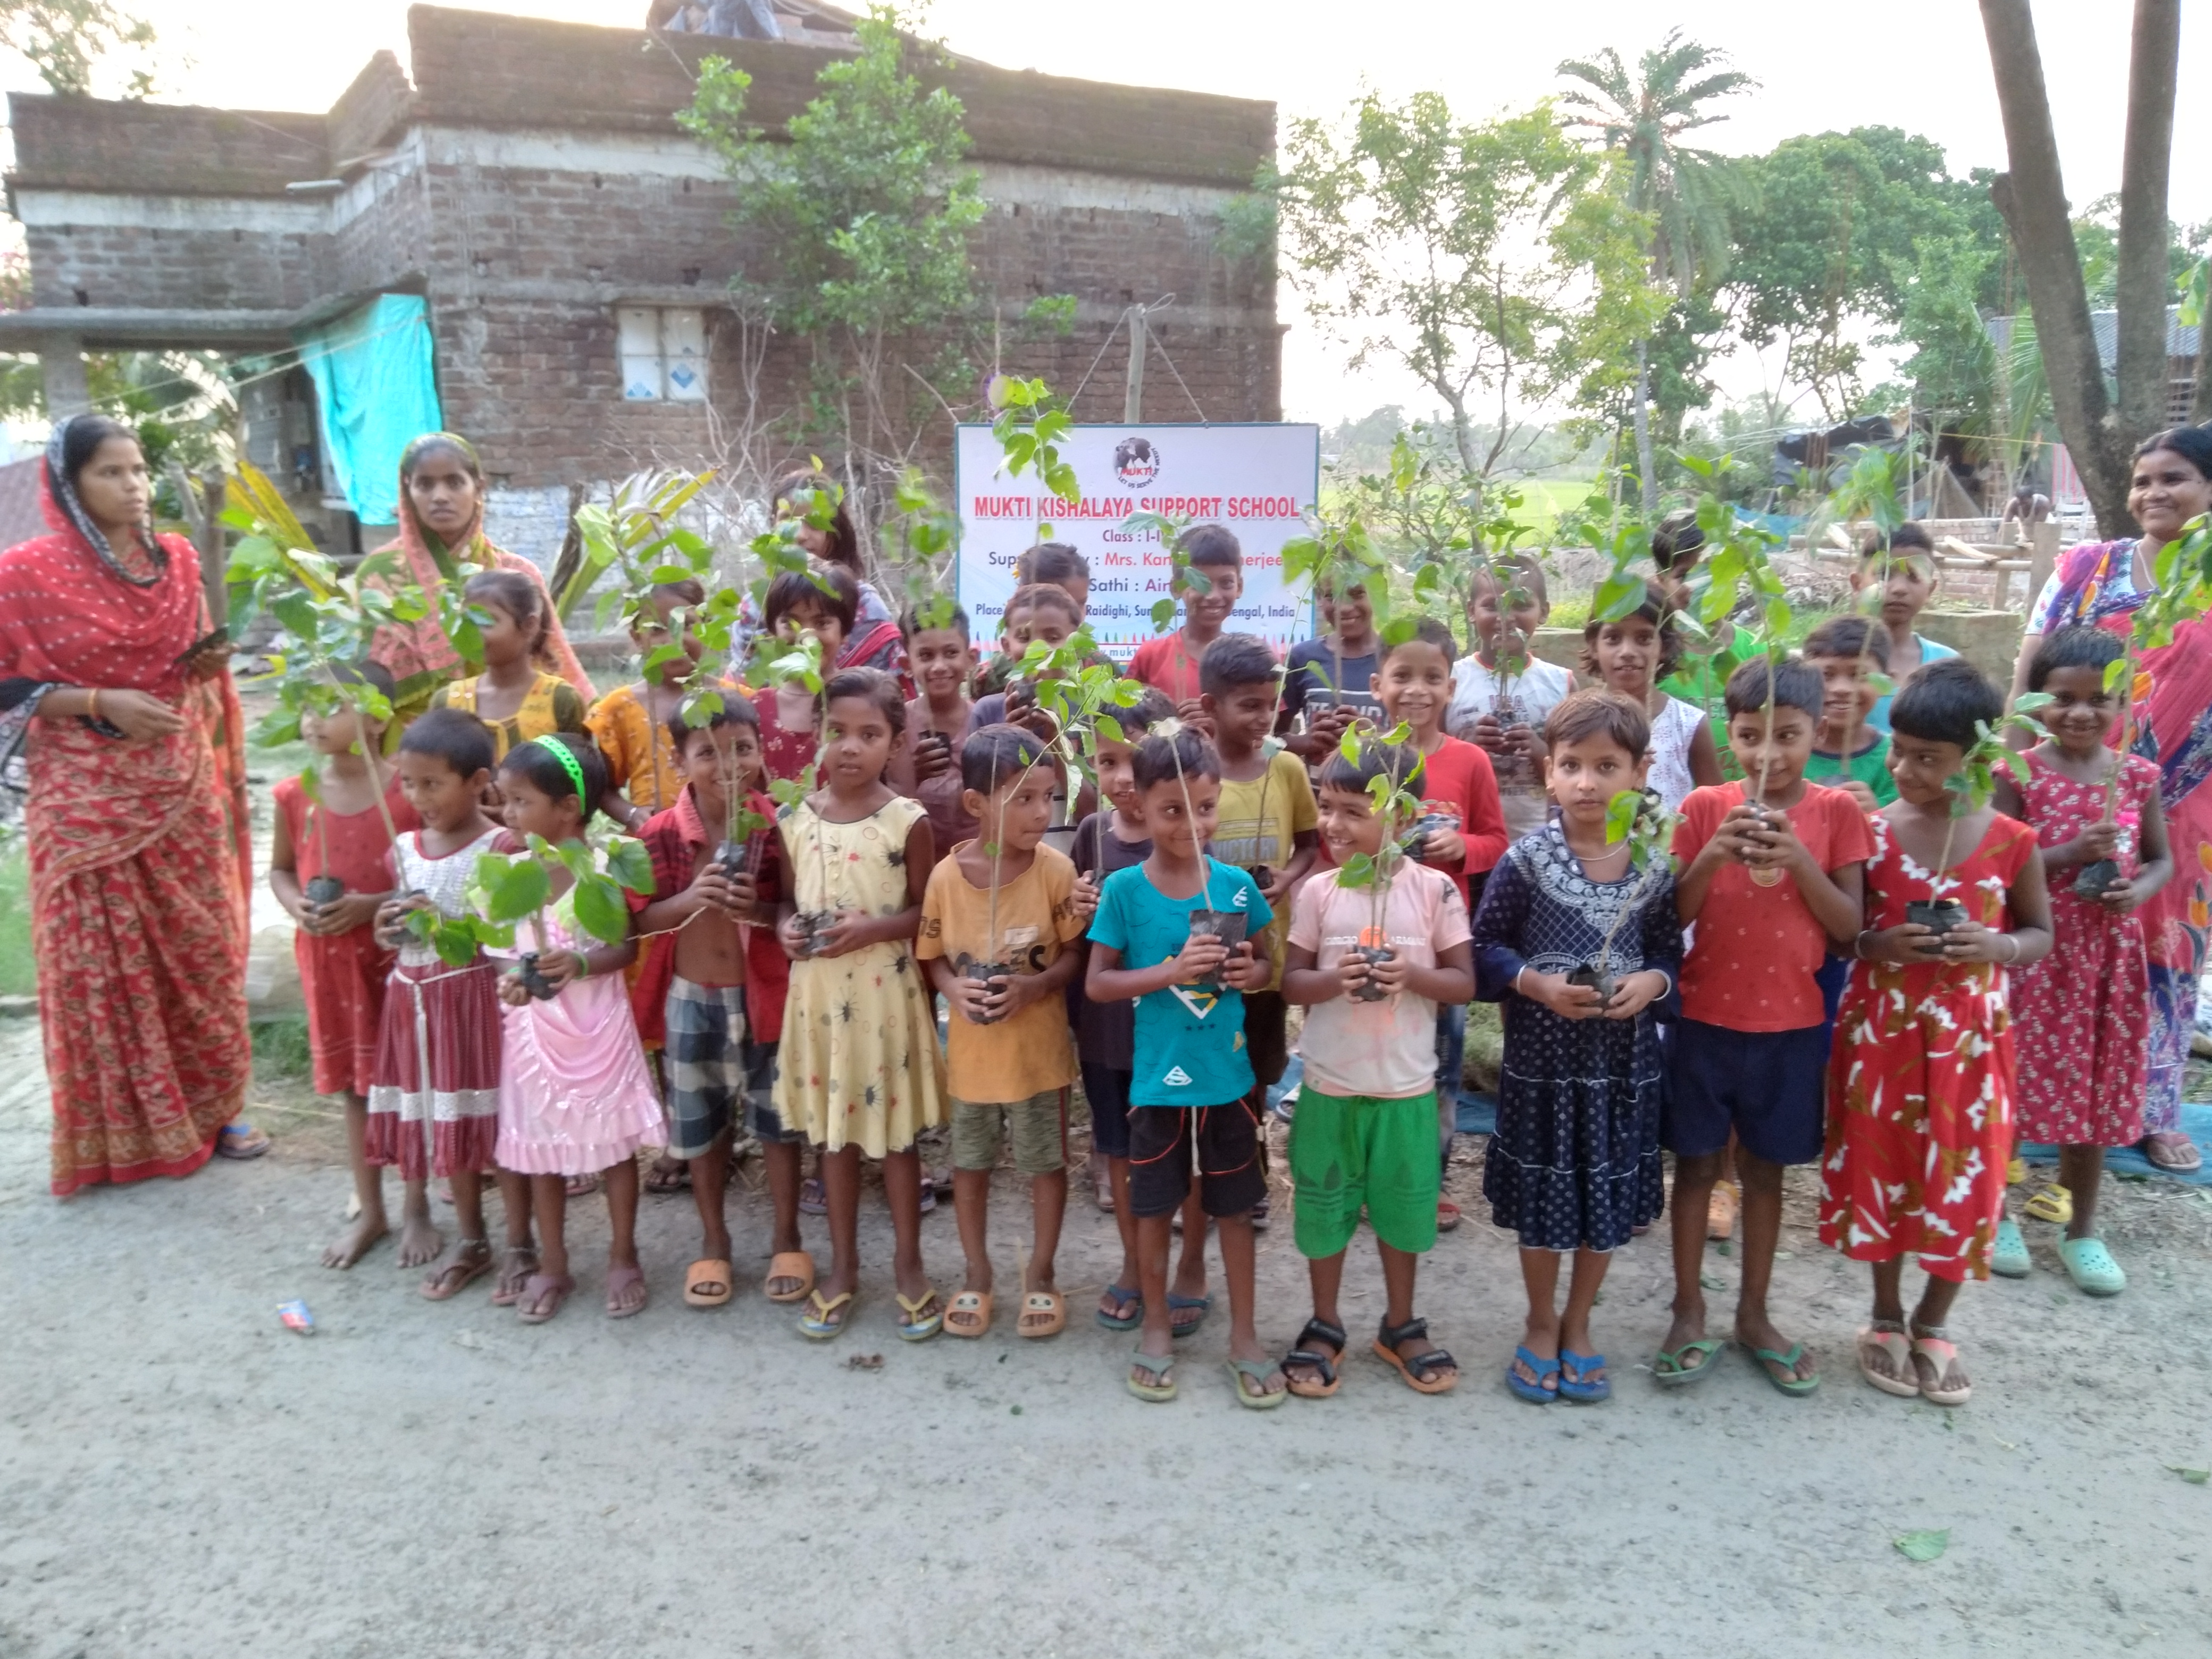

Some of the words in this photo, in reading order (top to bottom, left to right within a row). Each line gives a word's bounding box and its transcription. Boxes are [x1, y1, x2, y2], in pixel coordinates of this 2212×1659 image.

[975, 497, 1030, 517] MUKTI
[1037, 497, 1134, 517] KISHALAYA
[1141, 497, 1222, 517] SUPPORT
[1228, 497, 1300, 517] SCHOOL
[1102, 529, 1133, 542] Class
[988, 551, 1017, 568] Sup
[1105, 552, 1136, 566] Mrs.
[1088, 577, 1128, 591] Sathi
[1086, 604, 1131, 619] Raidighi,
[1228, 605, 1264, 619] engal,
[1269, 605, 1295, 617] India
